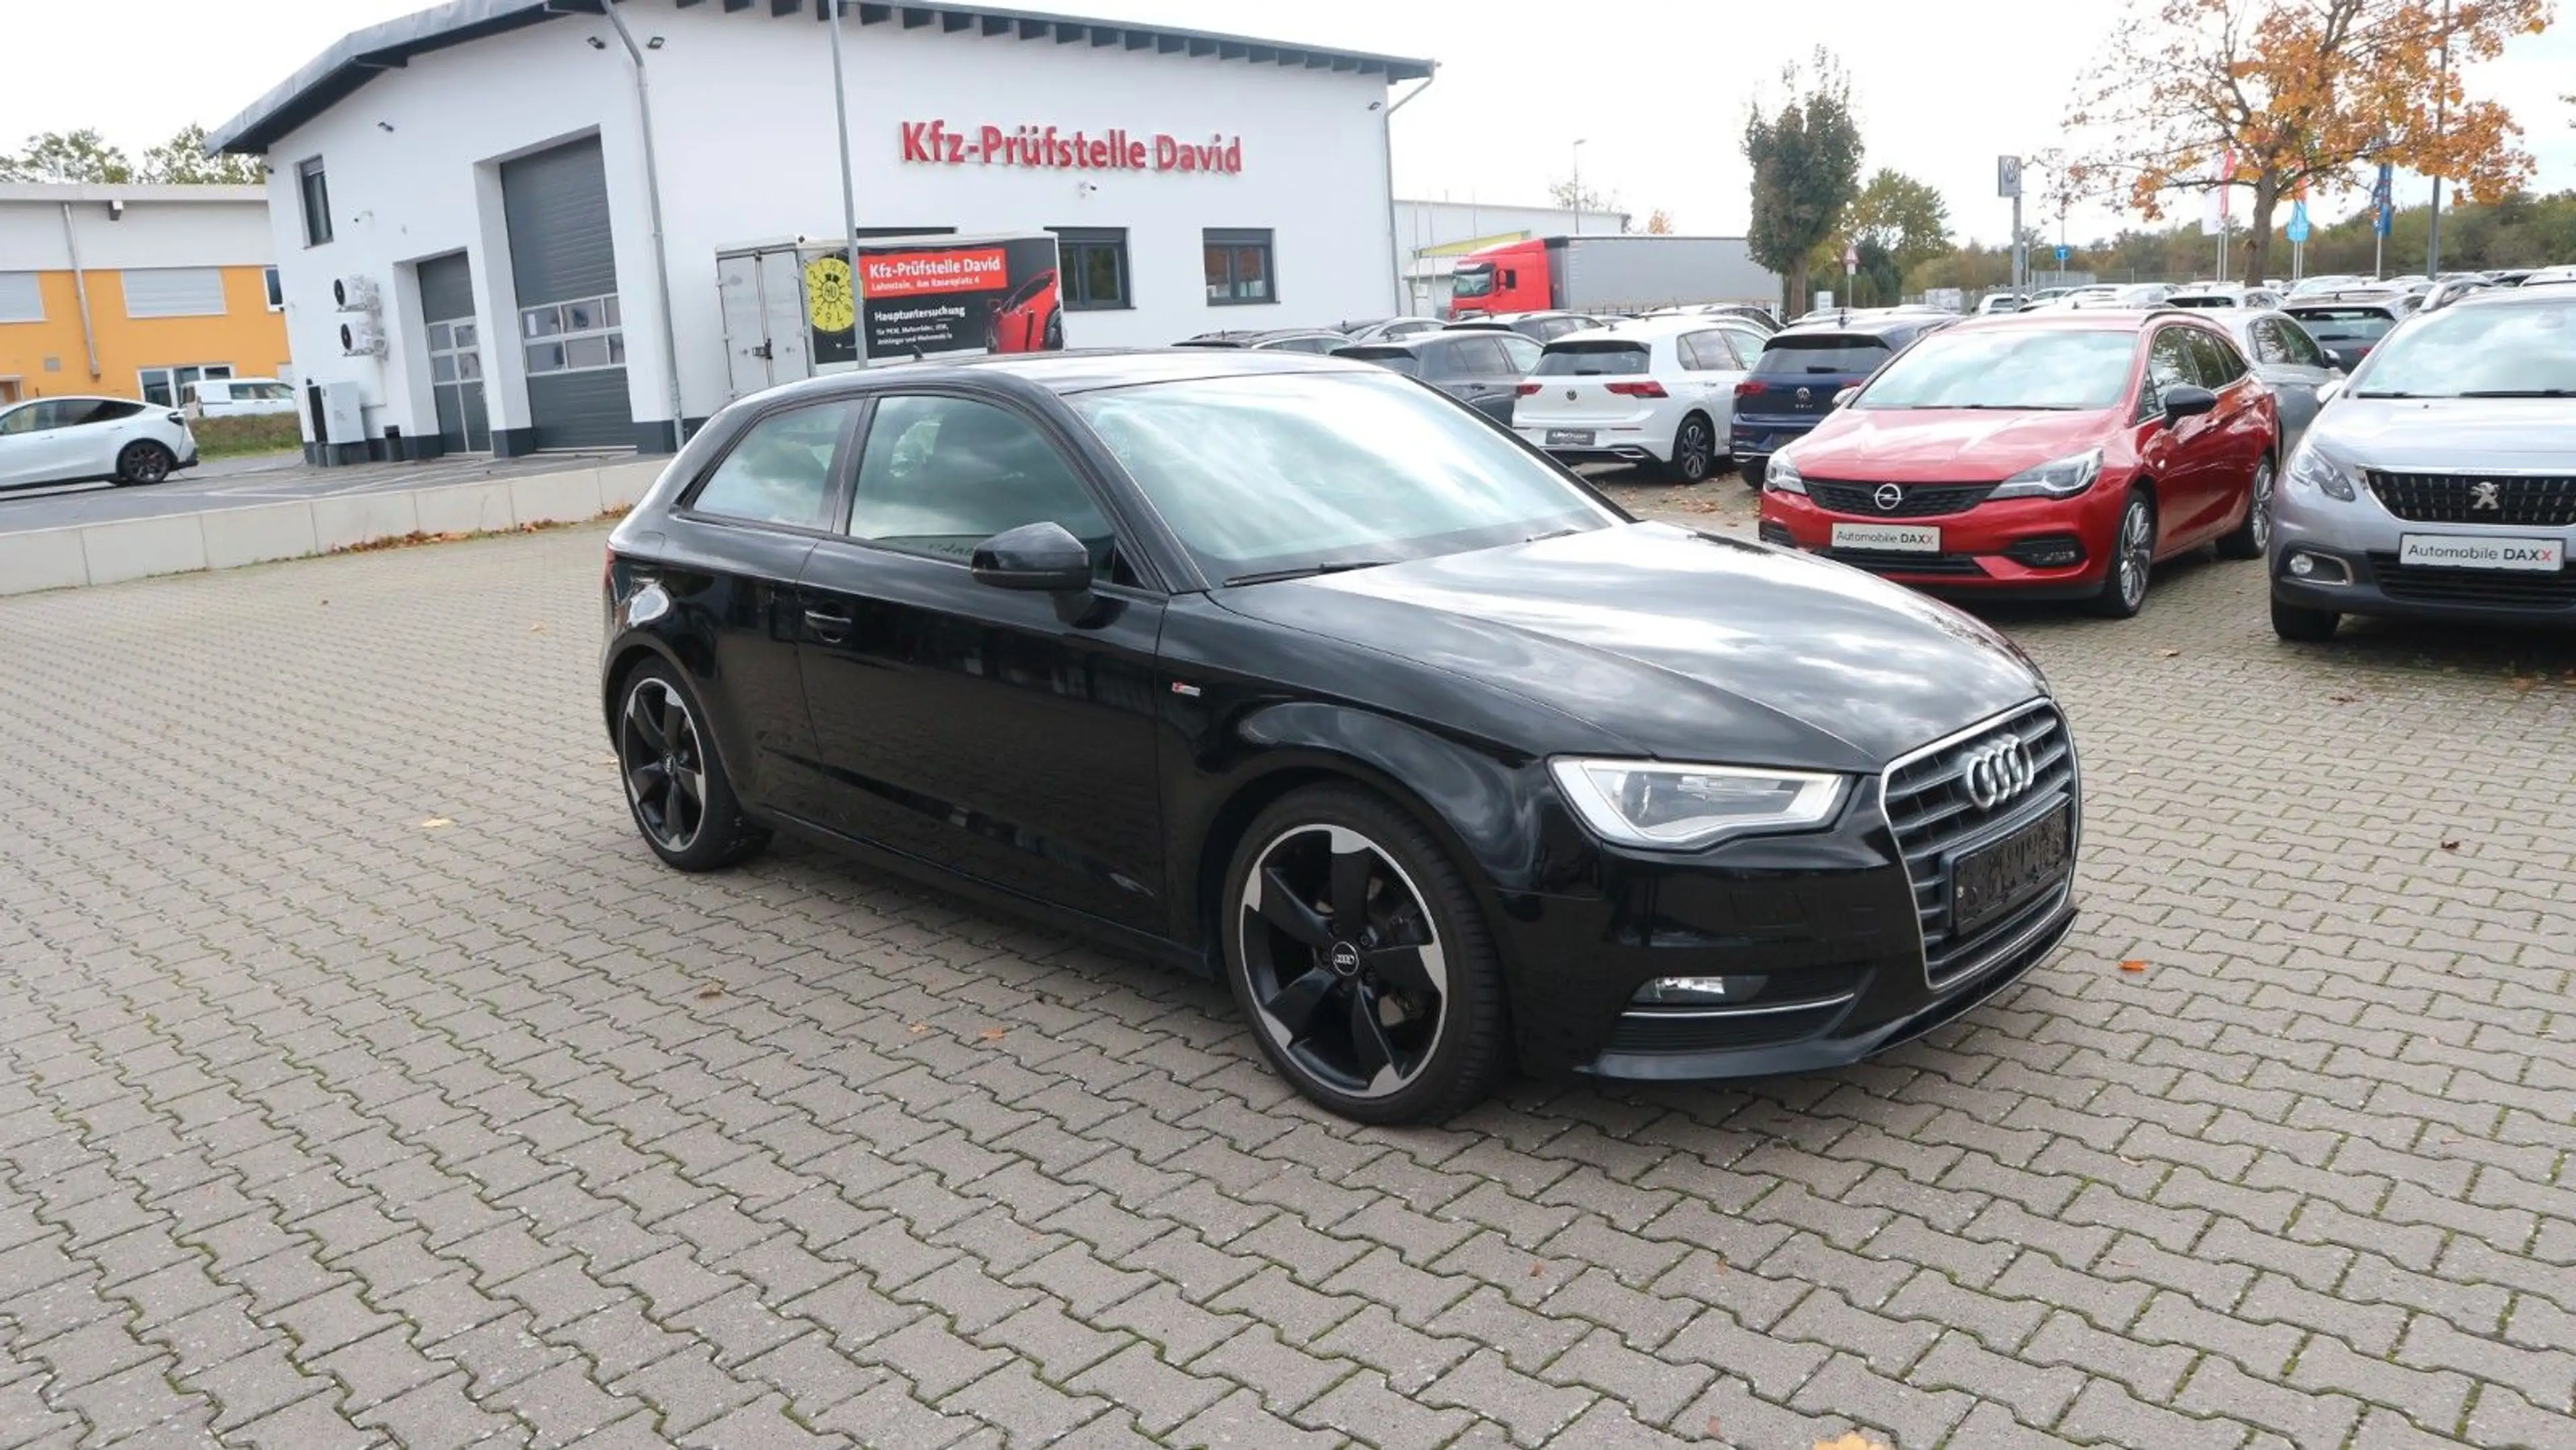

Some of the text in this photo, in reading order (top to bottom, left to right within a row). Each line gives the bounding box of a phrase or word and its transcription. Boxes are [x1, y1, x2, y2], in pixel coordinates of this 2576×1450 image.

[902, 119, 1242, 173] Kfz-Prüfstelle David
[869, 256, 1000, 278] Kfz-Prüfstelle David
[874, 306, 965, 322] Hauptuntersuchung
[1837, 531, 1933, 545] Automobile DAXX
[2408, 545, 2552, 561] Automobile DAXX
